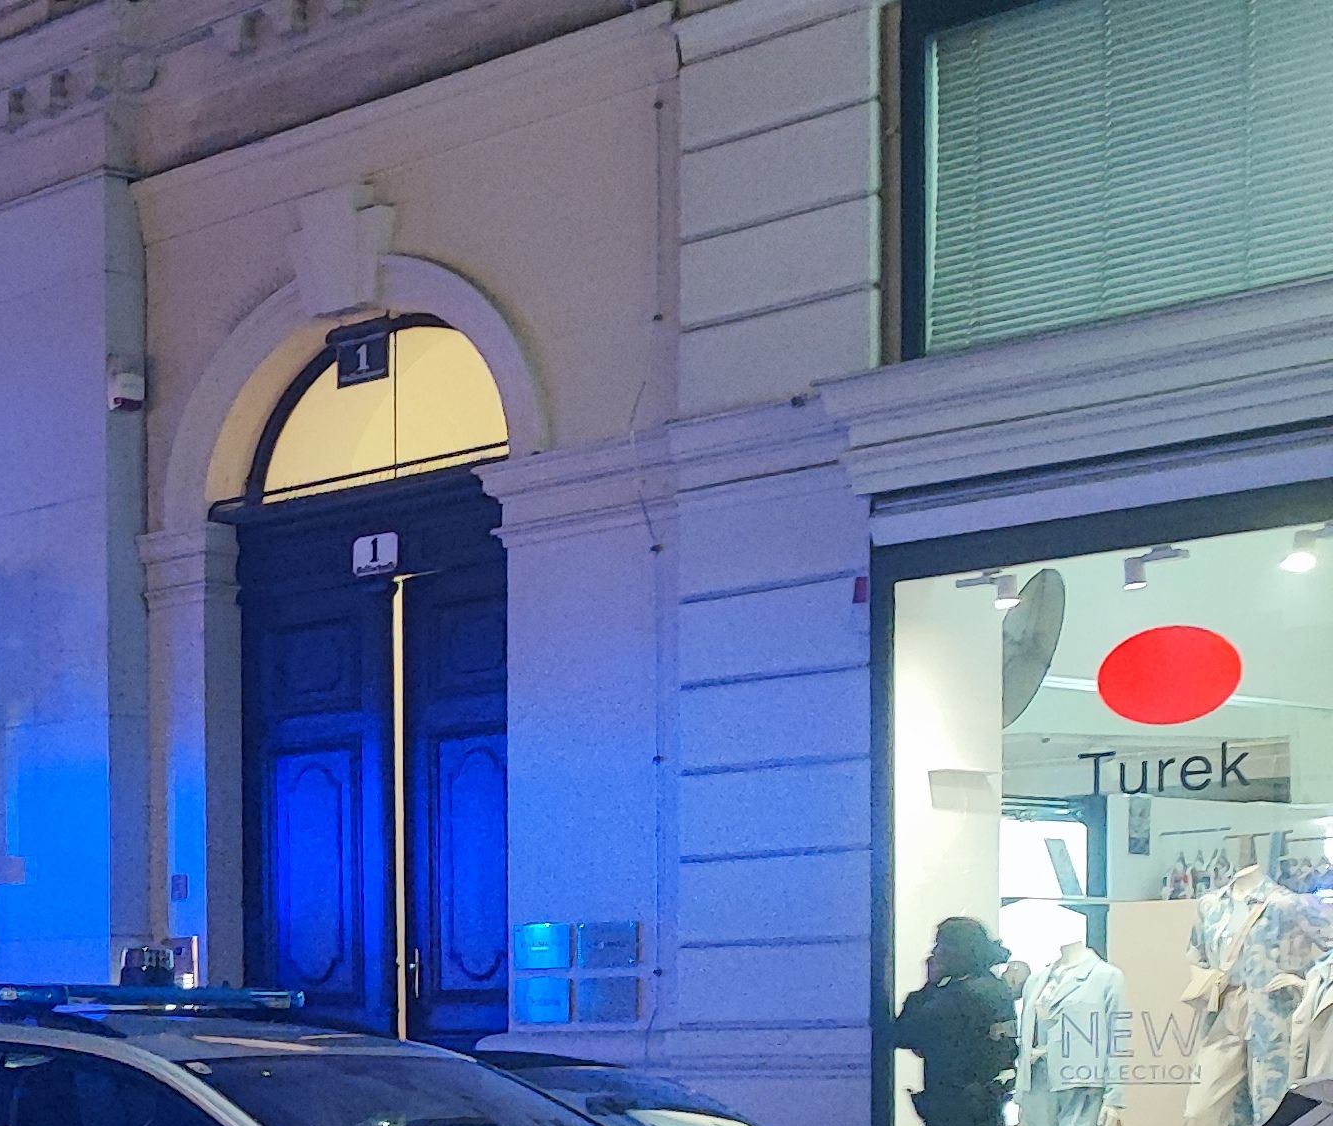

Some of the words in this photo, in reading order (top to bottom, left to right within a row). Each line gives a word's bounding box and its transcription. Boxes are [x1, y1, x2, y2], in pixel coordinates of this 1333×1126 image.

[356, 343, 370, 371] 1
[369, 537, 380, 563] 1
[1077, 741, 1251, 795] Turek
[1061, 1011, 1201, 1058] NEW
[1060, 1064, 1202, 1081] COLLECTION
